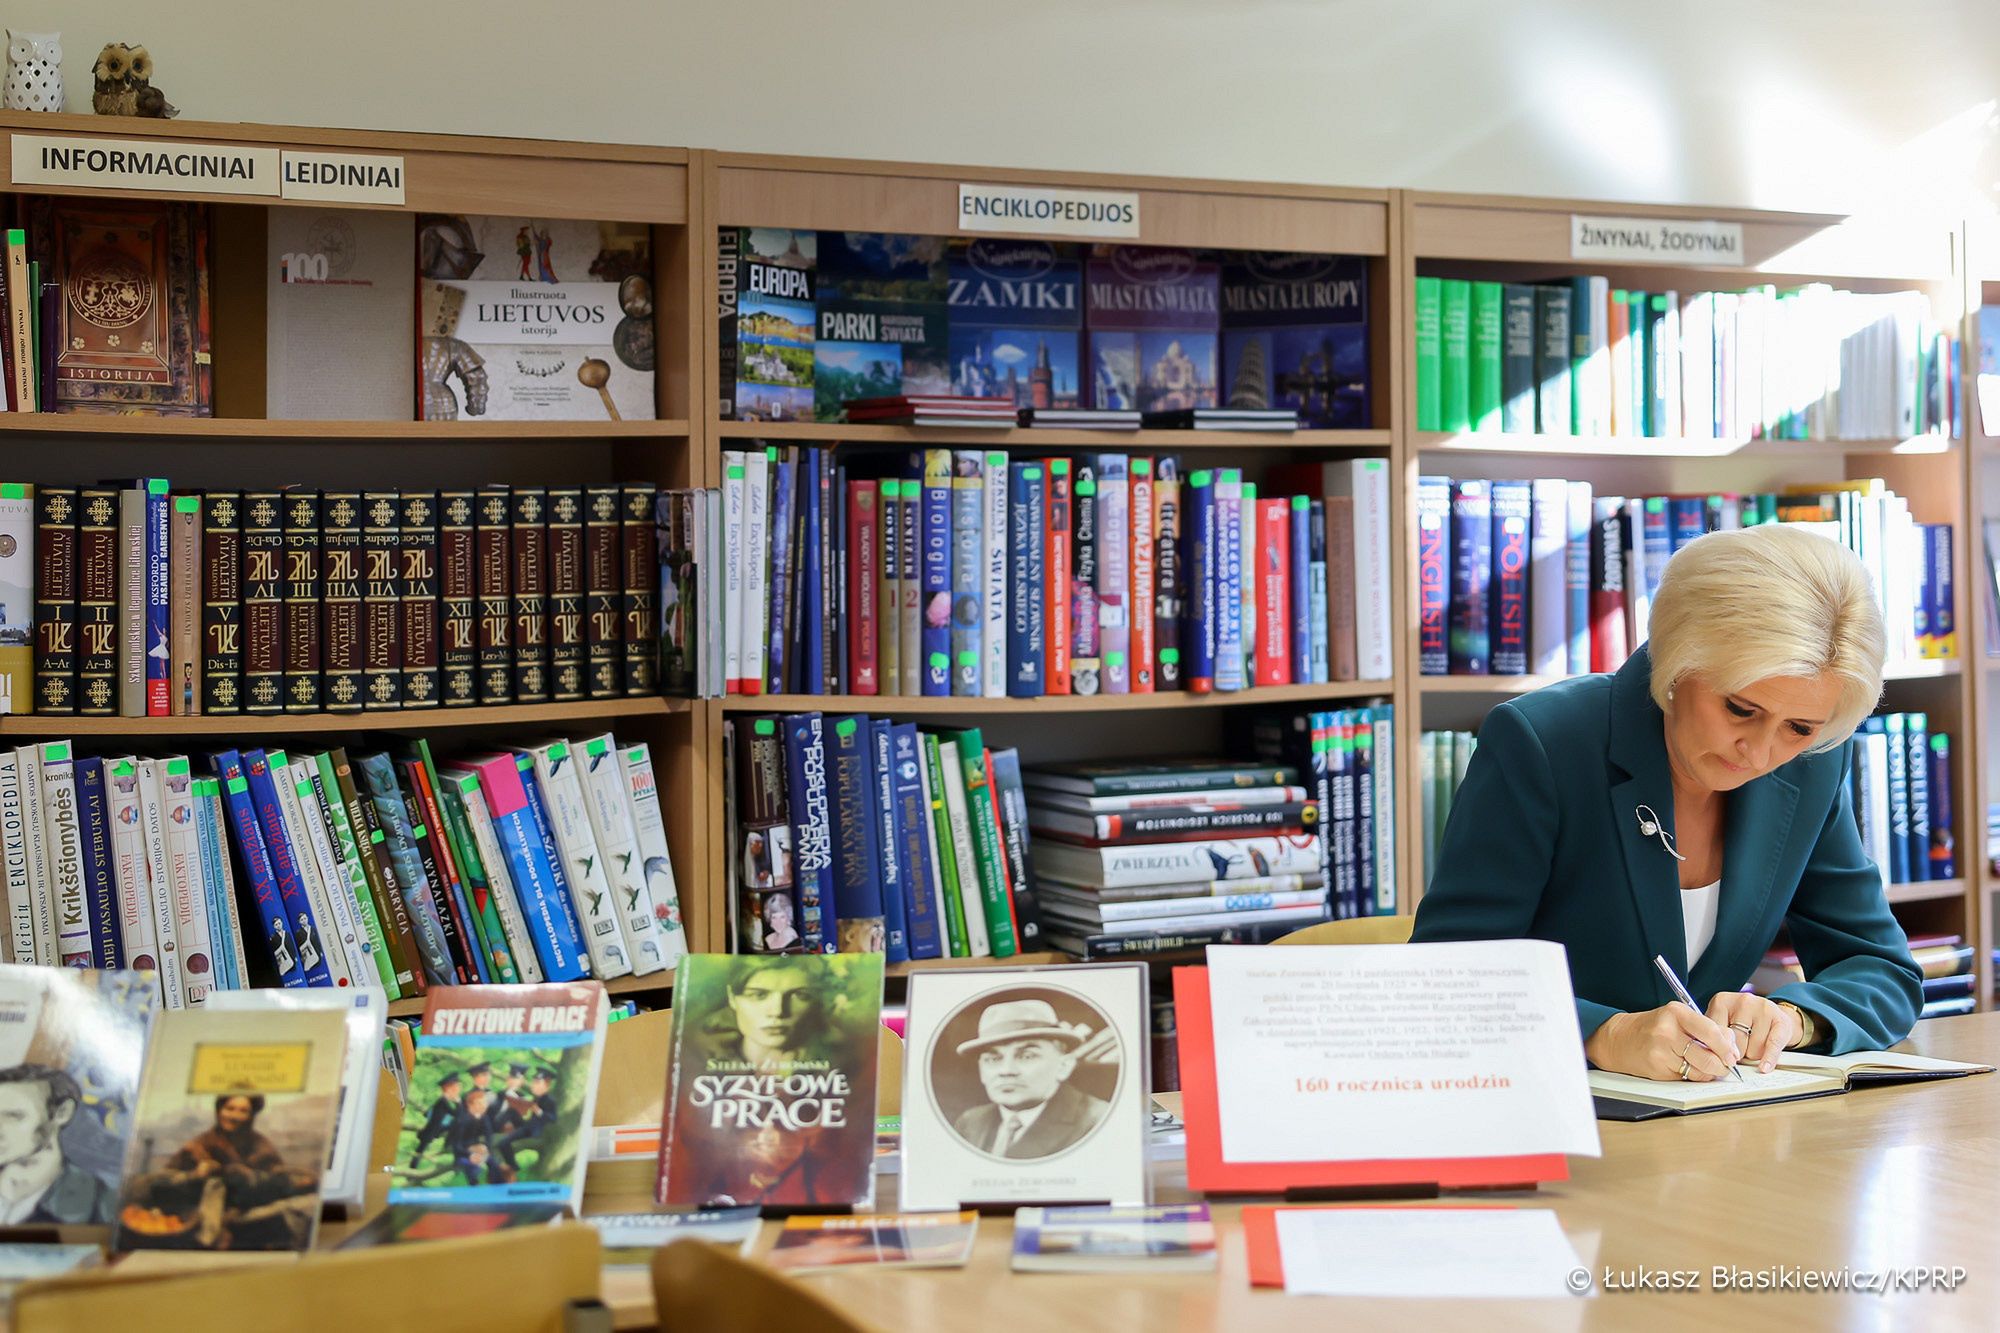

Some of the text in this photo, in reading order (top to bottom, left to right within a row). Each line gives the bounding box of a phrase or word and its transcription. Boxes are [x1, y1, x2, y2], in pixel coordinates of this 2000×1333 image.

[42, 146, 400, 188] INFORMACINIAI LEIDINIAI
[962, 195, 1134, 224] ENCIKLOPEDIJOS
[1580, 225, 1736, 254] ŽINYNAI, ŽODYNAI
[717, 229, 737, 320] EUROPA
[750, 263, 809, 300] EUROPA
[948, 279, 1076, 310] ZAMKI
[1290, 280, 1361, 309] EUROPY
[477, 304, 606, 324] LIETUVOS
[521, 325, 558, 337] istorija
[822, 311, 876, 341] PARKI
[70, 368, 154, 381] ISTORIJA
[52, 531, 66, 596] LIETUVIŲ
[95, 533, 107, 598] LIETUVIŲ
[159, 501, 169, 606] PASAULIO GARSENYBĖS
[219, 534, 232, 599] LIETUVIŲ
[729, 522, 741, 591] Encyklopedia
[749, 522, 761, 591] Encyklopedia
[927, 489, 946, 585] Biologia
[961, 490, 976, 584] Historia
[1133, 481, 1151, 597] GIMNAZJUM
[128, 569, 142, 611] Republice
[151, 554, 159, 607] OKSFORDO
[905, 589, 918, 608] 2
[1015, 555, 1027, 634] POLSKIEGO
[128, 622, 142, 653] polskie
[45, 771, 74, 782] kronika
[878, 732, 889, 772] Europy
[803, 746, 824, 870] POPULARNA
[810, 718, 833, 869] ENCYKLOPEDIA
[837, 756, 854, 848] POPULARNA
[881, 774, 892, 811] miasta
[1, 763, 26, 889] ENCIKLOPEDIJA
[53, 786, 82, 926] Krikščionybės
[89, 794, 106, 867] STEBUKLAI
[238, 807, 273, 904] XX amžiaus
[262, 803, 299, 901] XX amžiaus
[512, 812, 538, 880] DOCIEKLIWYCH
[797, 824, 813, 871] PWN
[121, 853, 139, 927] FAKTOPEDIJA
[148, 801, 171, 934] PASAULIO ISTORIJOS DATOS
[174, 853, 192, 926] FAKTOPEDIJA
[329, 801, 382, 953] PTAKI świata
[542, 835, 565, 887] SZTUKI
[1112, 855, 1191, 873] ZWIERZĘTA
[96, 870, 112, 933] PASAULIO
[423, 857, 454, 937] WYNALAZKI
[540, 900, 565, 968] ENCYKLOPEDIA
[432, 1005, 589, 1035] SYZYFOWE PRACE
[688, 1068, 851, 1108] SYZYFOWE
[710, 1097, 847, 1132] PRACE
[1294, 1073, 1511, 1094] 160 rocznica urodzin
